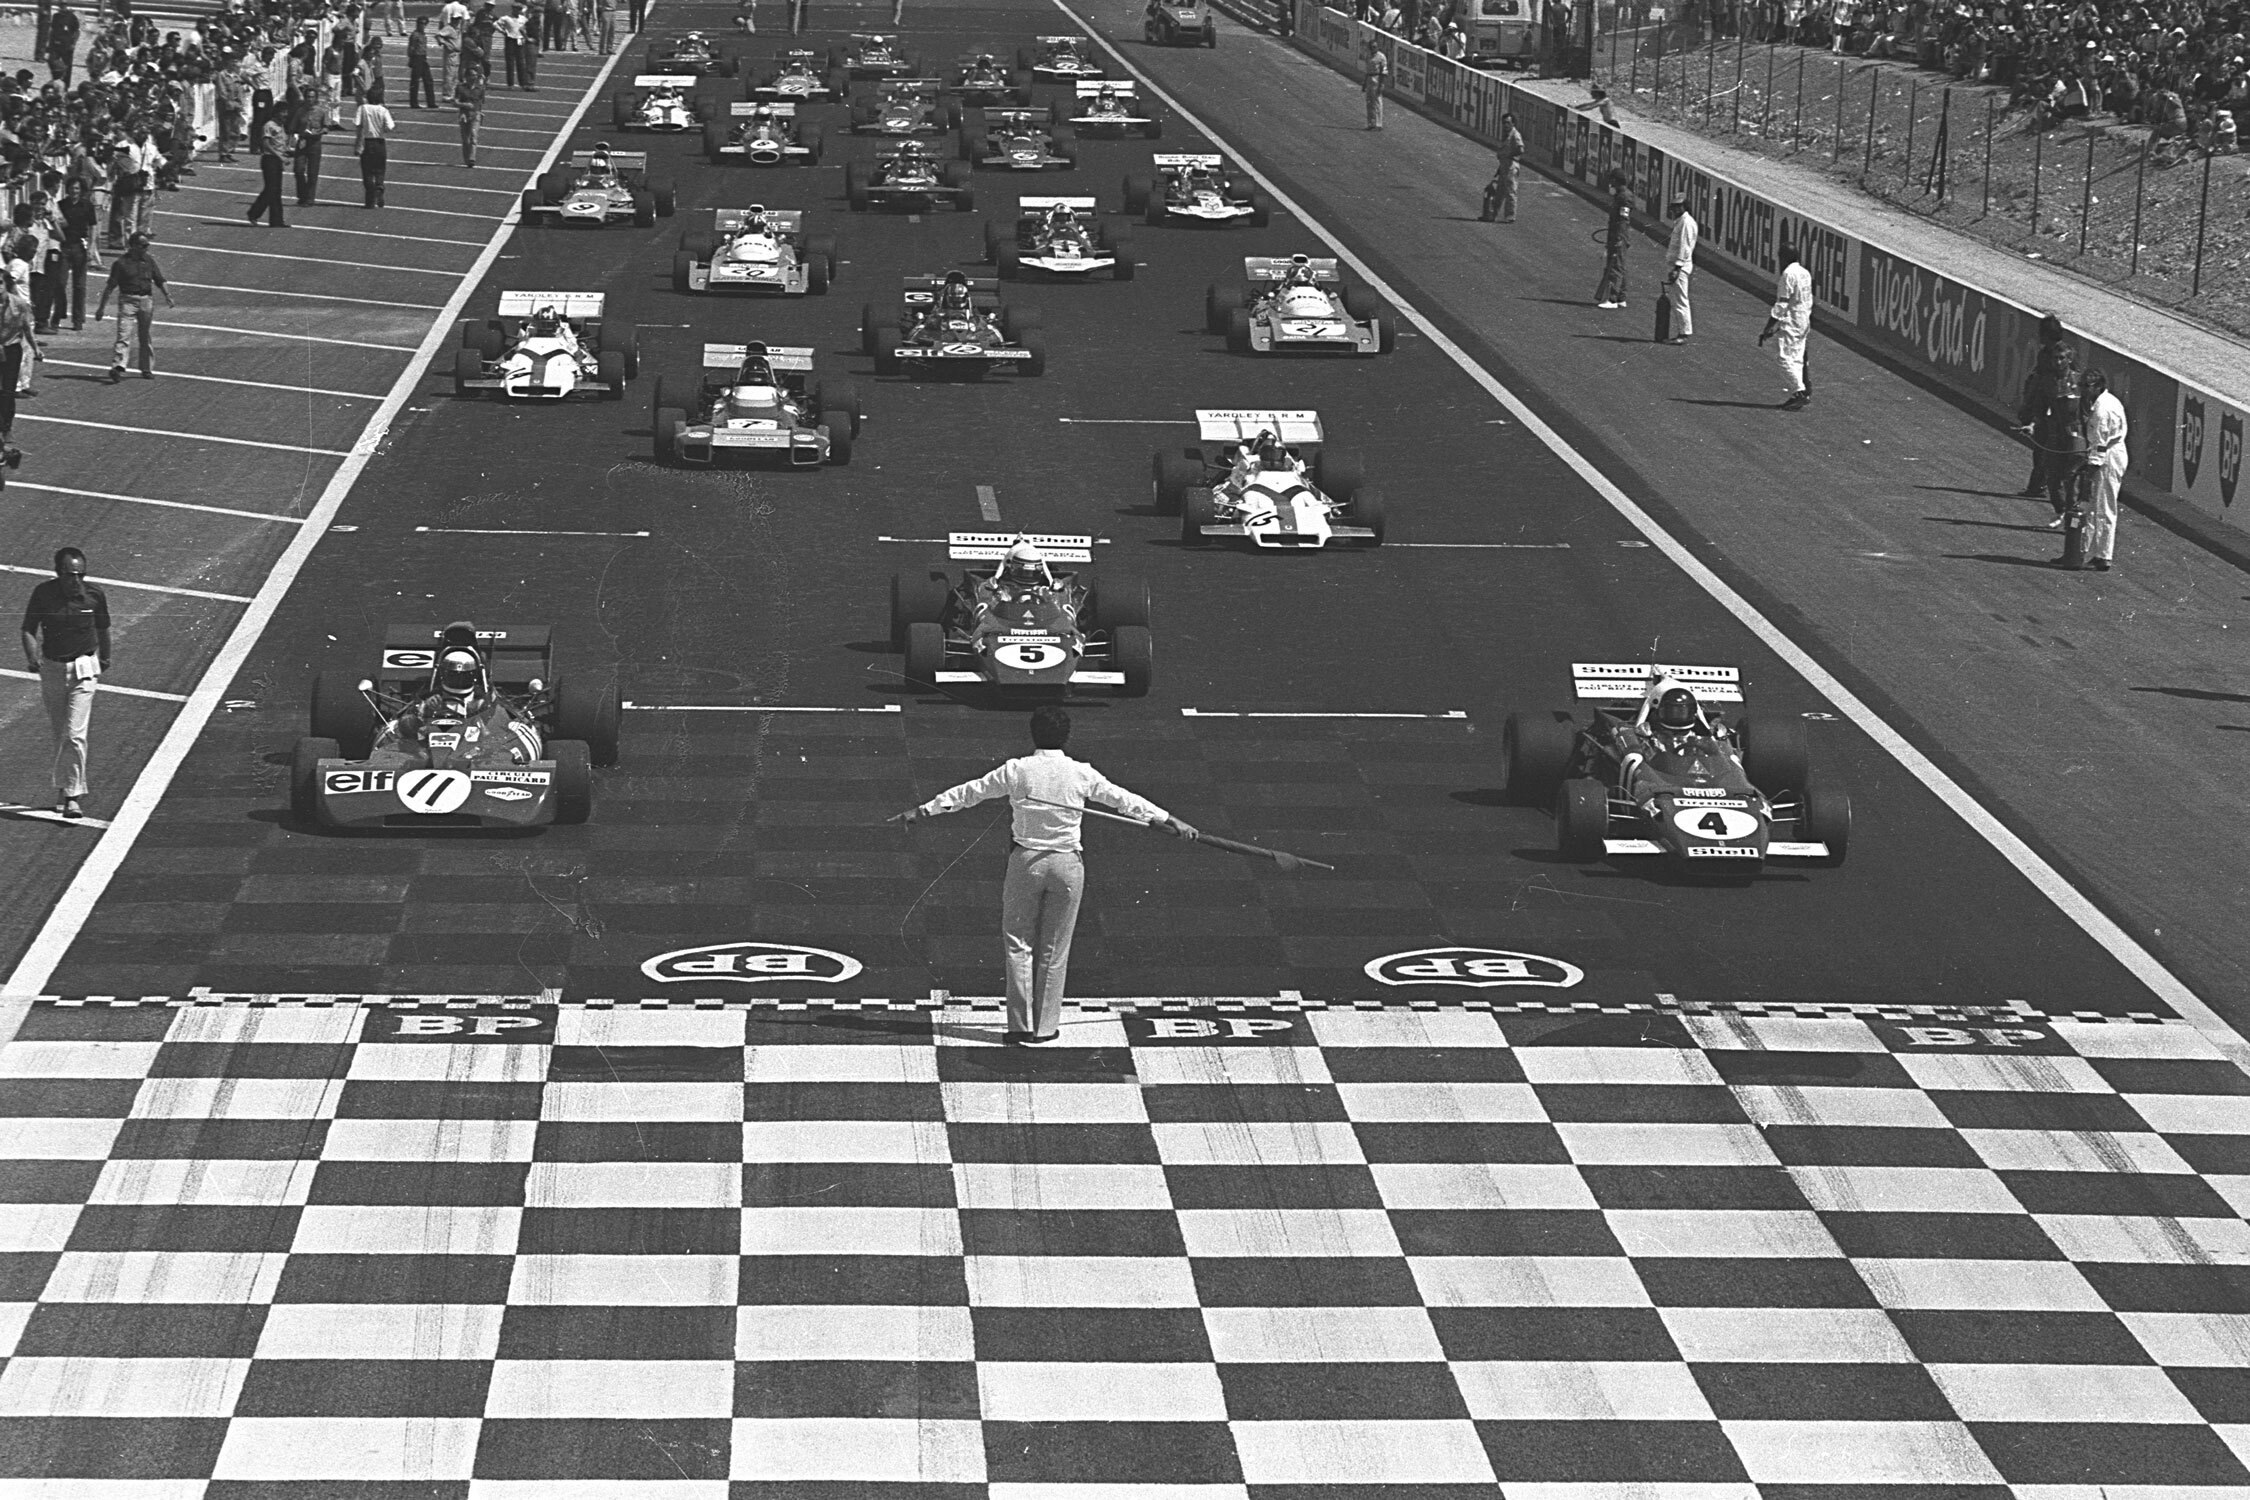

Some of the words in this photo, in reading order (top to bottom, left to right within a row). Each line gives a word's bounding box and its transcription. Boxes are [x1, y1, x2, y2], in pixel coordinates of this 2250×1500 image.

[1725, 186, 1776, 275] LOCATEL
[731, 267, 765, 277] 20
[1295, 324, 1327, 336] 21
[742, 419, 762, 429] 7
[2186, 417, 2202, 464] BP
[2222, 428, 2242, 474] BP
[956, 535, 1007, 543] Shell
[1032, 536, 1085, 544] Shell
[1019, 645, 1046, 663] 5
[1581, 666, 1643, 675] Shell
[1669, 667, 1731, 677] Shell
[326, 771, 395, 793] elf
[406, 772, 456, 807] 11
[505, 776, 547, 784] RICARD
[1697, 812, 1728, 836] 4
[1691, 847, 1755, 856] Shell
[671, 952, 808, 973] BP
[1396, 957, 1541, 979] BP
[394, 1014, 543, 1036] BP
[1147, 1018, 1294, 1039] BP
[1898, 1026, 2048, 1048] BP
